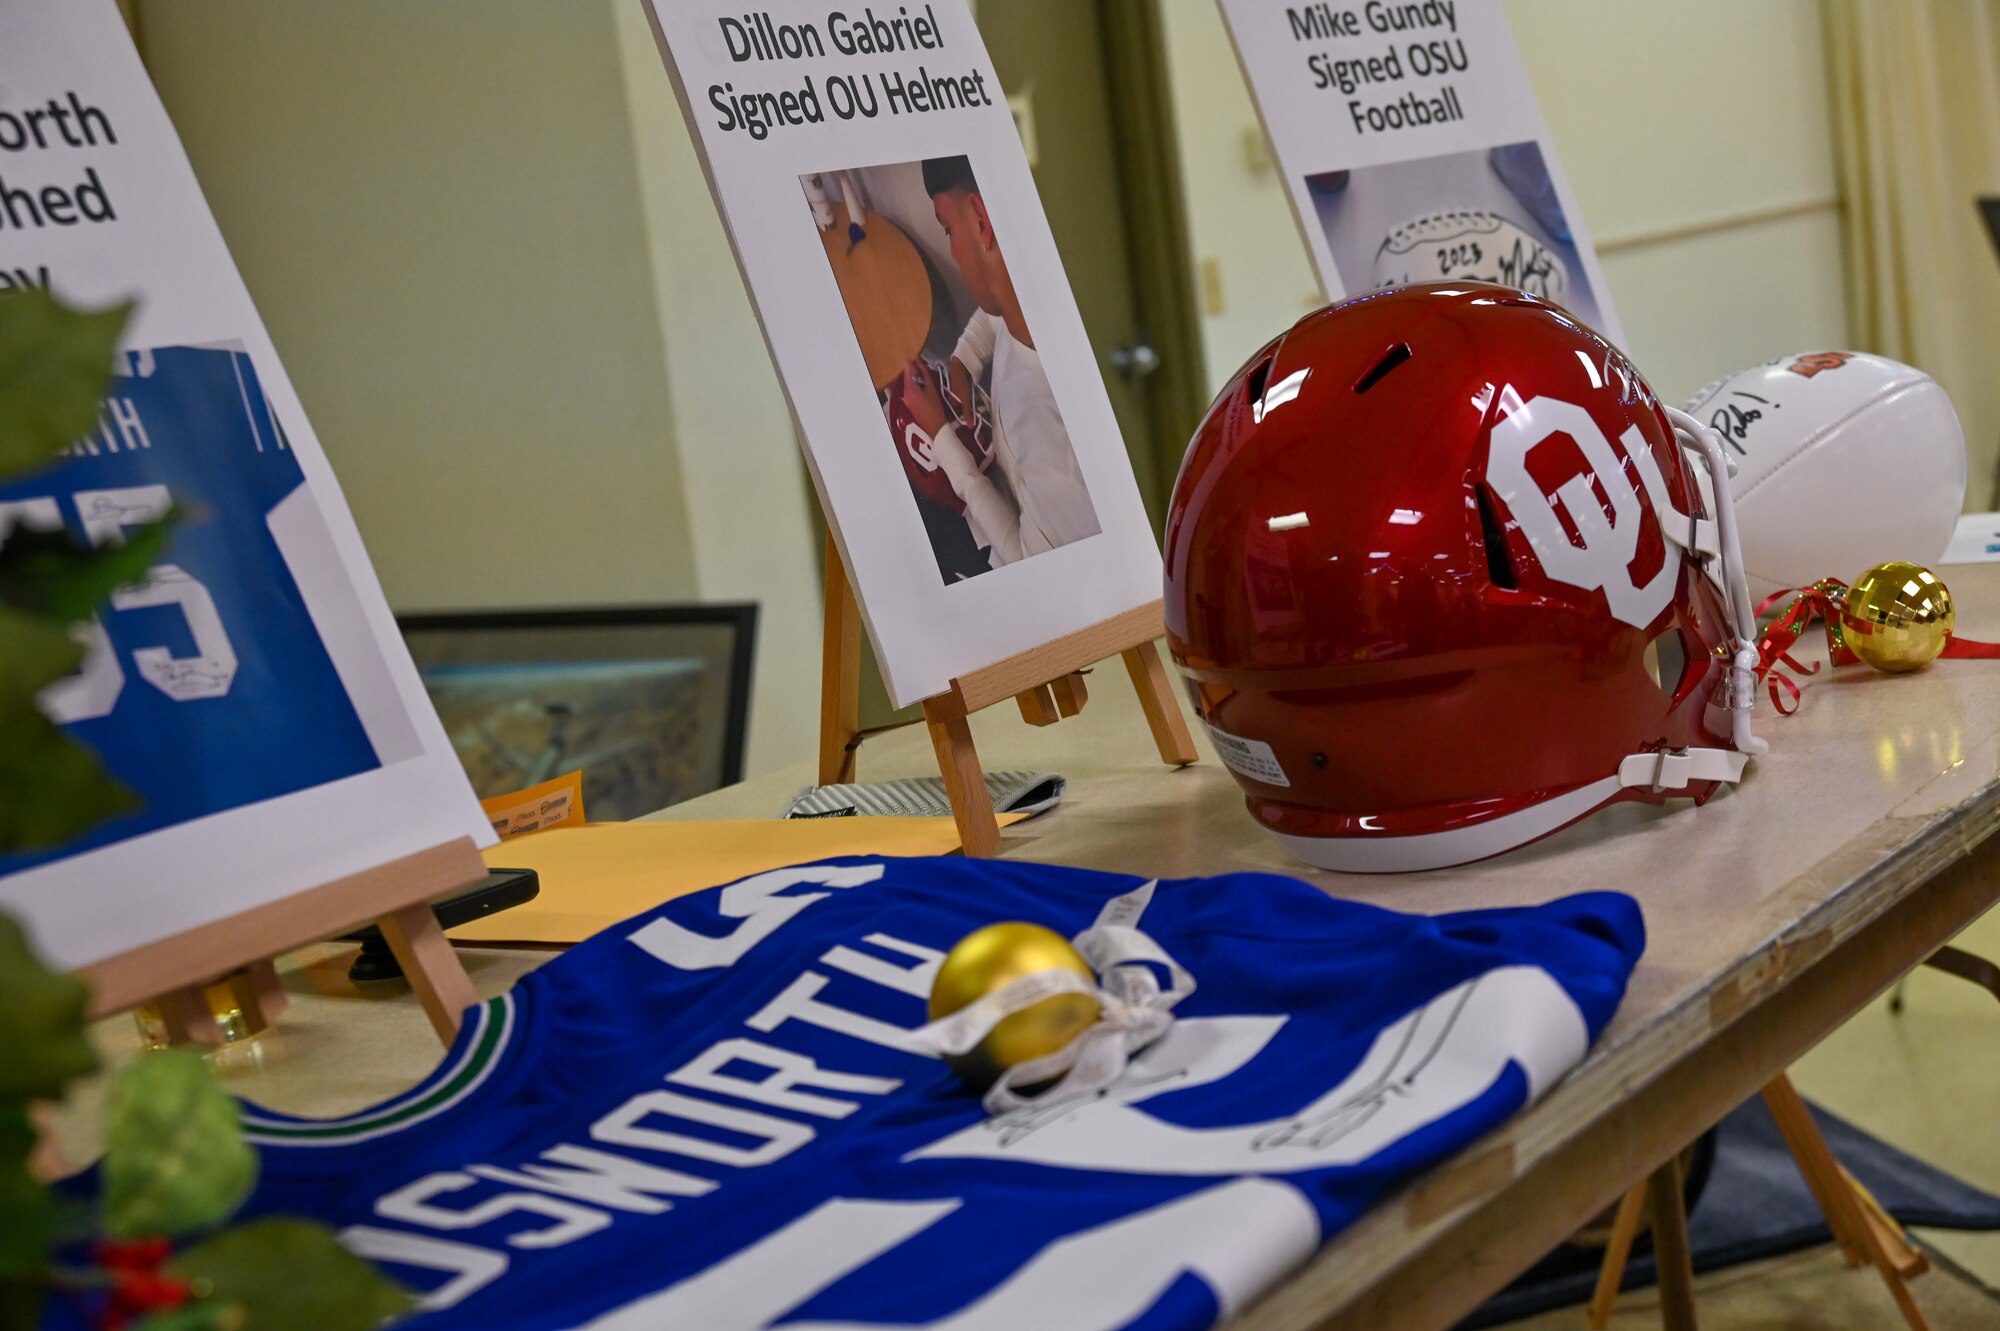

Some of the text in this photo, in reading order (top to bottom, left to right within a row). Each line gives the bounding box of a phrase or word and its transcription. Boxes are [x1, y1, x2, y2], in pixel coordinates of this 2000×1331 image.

[718, 4, 944, 62] Dillon Gabriel
[1286, 0, 1458, 41] Mike Gundy
[1307, 39, 1469, 94] Signed OSU
[0, 91, 118, 151] orth
[708, 66, 993, 140] Signed OU Helmet
[1348, 86, 1464, 134] Football
[0, 167, 117, 229] hed
[1485, 395, 1683, 630] OU
